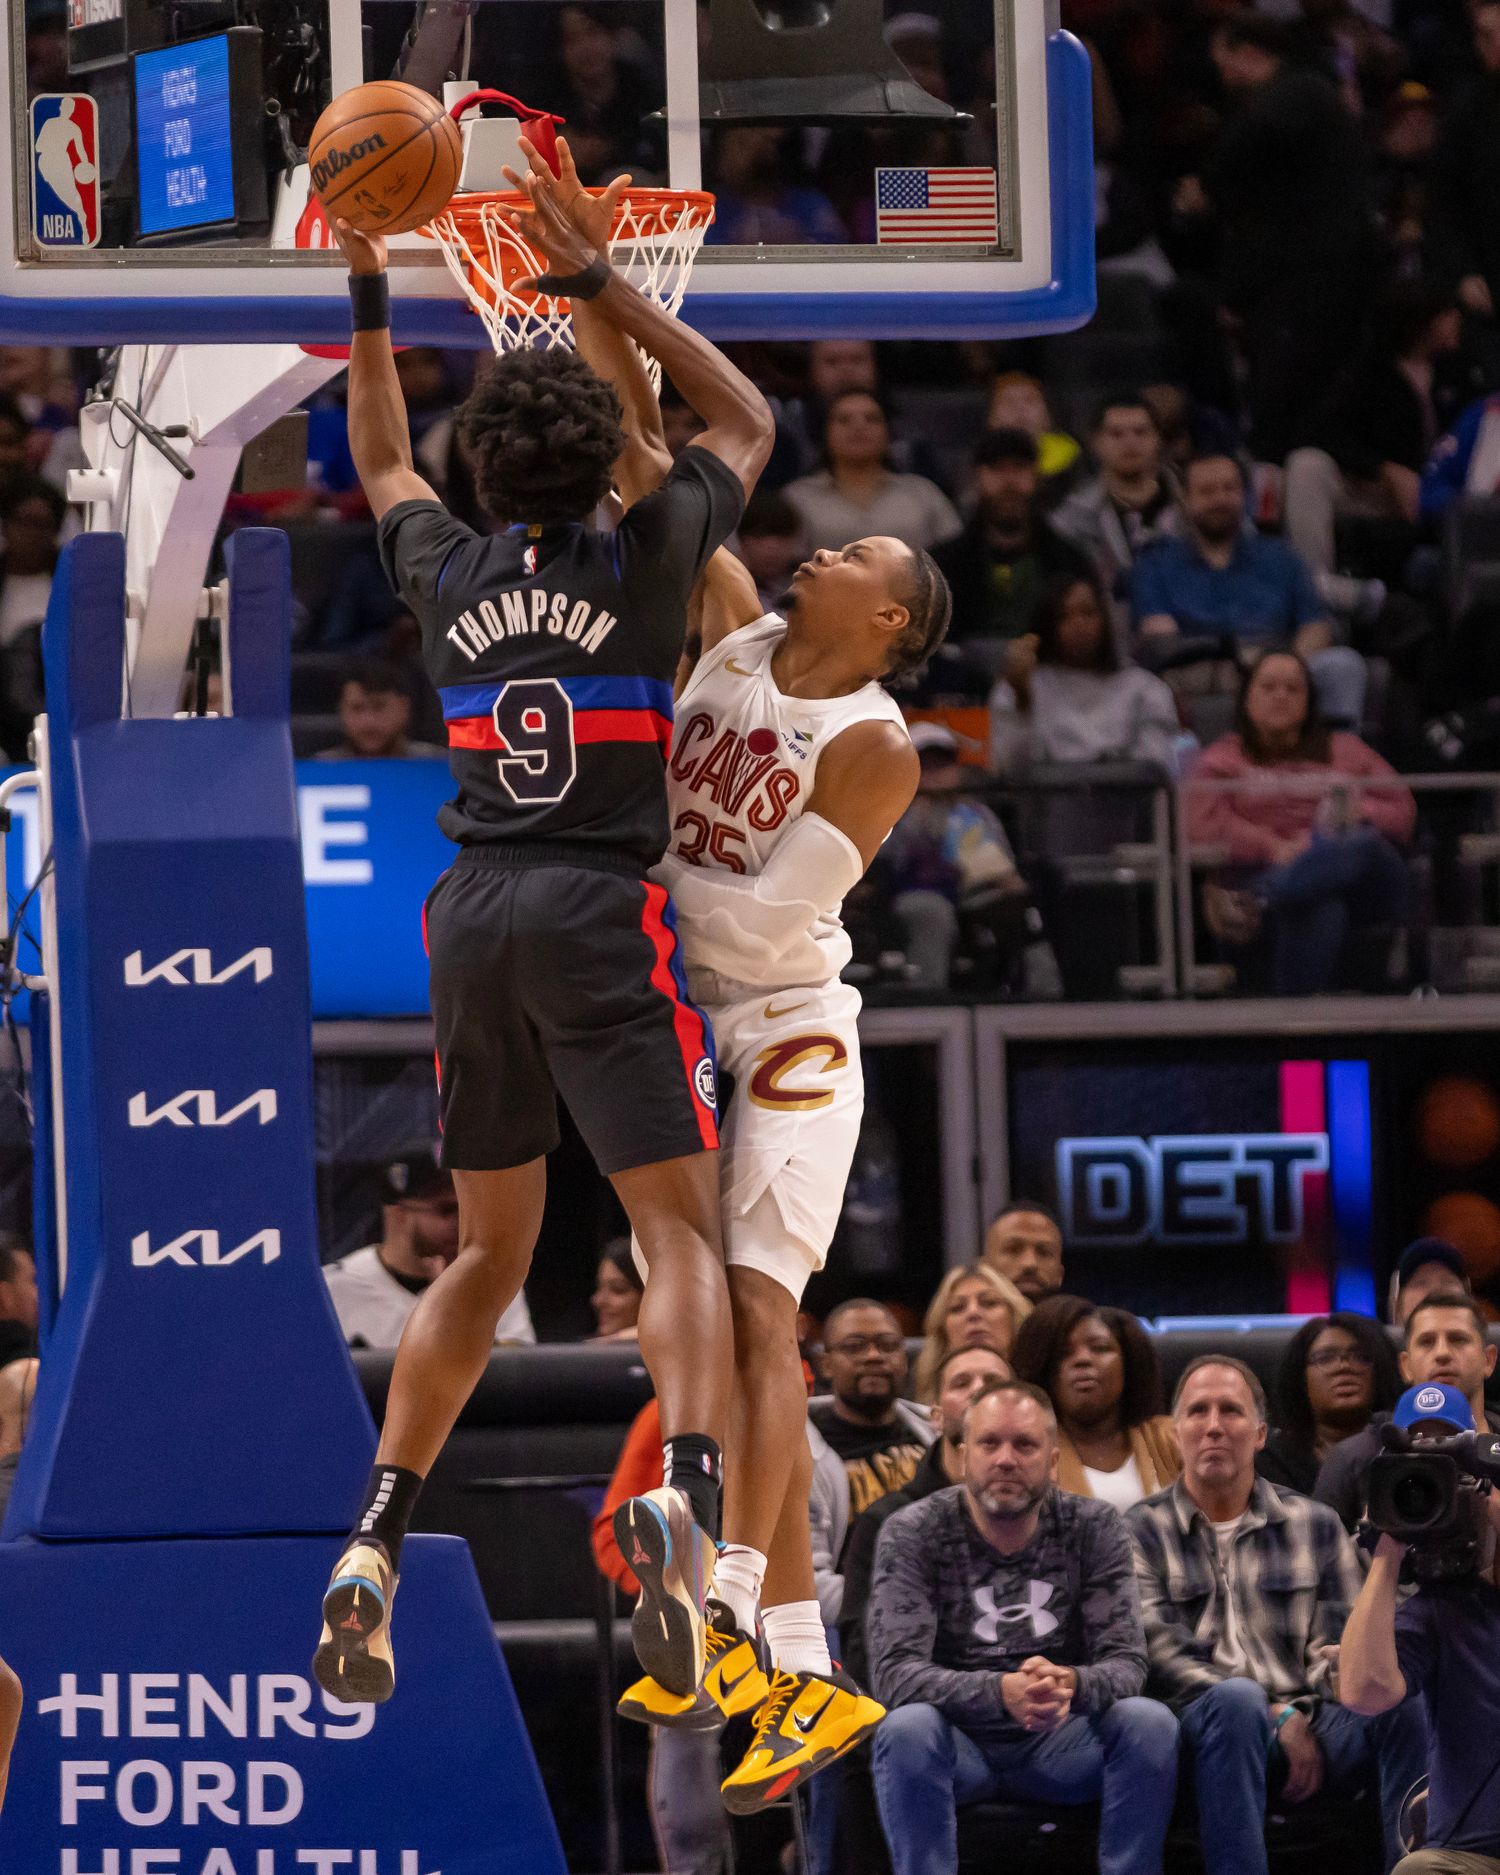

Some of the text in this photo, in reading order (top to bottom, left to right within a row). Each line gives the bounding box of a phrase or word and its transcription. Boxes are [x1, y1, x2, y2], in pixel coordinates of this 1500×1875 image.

[43, 214, 75, 238] NBA
[446, 588, 618, 662] THOMPSON
[492, 677, 577, 803] 9
[671, 712, 800, 832] CAVS
[674, 808, 747, 875] 35
[124, 947, 273, 986] KIA
[128, 1089, 277, 1126] KIA
[1055, 1132, 1329, 1244] DET
[132, 1229, 281, 1266] KIA
[1421, 1393, 1441, 1404] DET
[38, 1673, 376, 1739] HENRY
[60, 1759, 303, 1826] FORD
